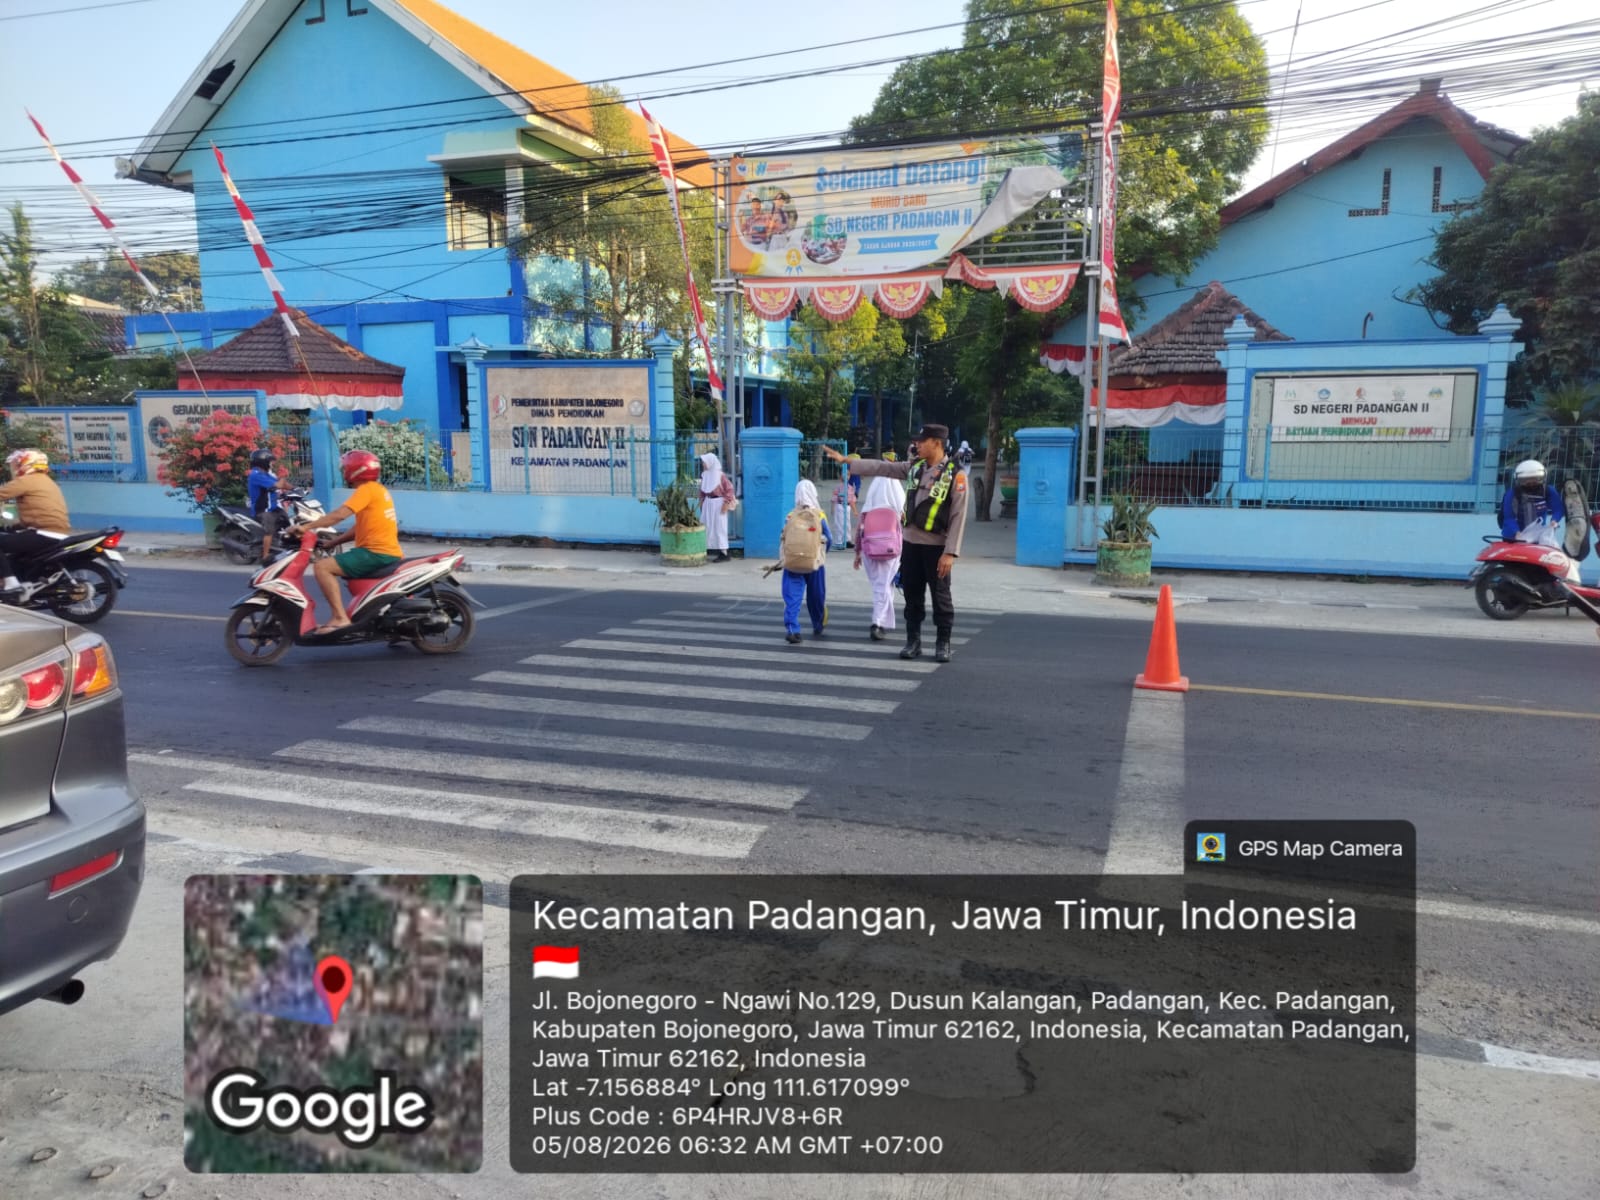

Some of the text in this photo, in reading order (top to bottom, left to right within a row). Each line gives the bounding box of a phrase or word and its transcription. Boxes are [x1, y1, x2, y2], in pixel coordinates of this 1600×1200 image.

[815, 157, 987, 193] Selamat Datang!
[826, 215, 843, 234] SD
[847, 214, 889, 233] NEGERI
[892, 209, 960, 230] PADANGAN
[172, 404, 211, 415] GERAKAN
[531, 409, 605, 418] DINAS PENDIDIKAN
[1293, 403, 1430, 414] SD NEGERI PADANGAN II
[542, 426, 613, 450] PADANGAN
